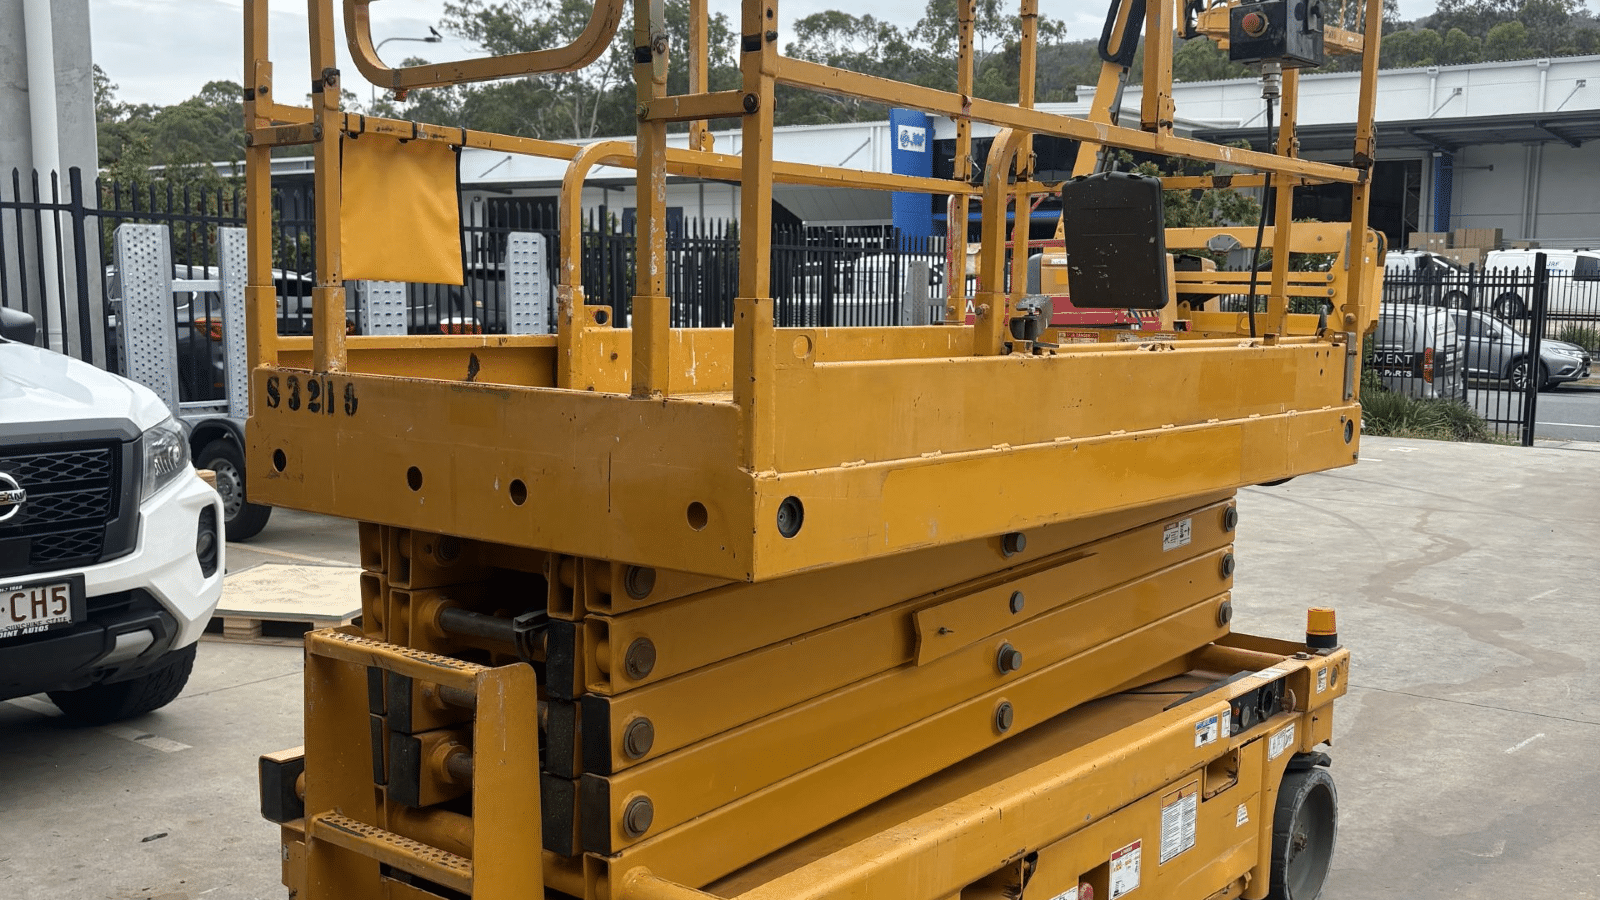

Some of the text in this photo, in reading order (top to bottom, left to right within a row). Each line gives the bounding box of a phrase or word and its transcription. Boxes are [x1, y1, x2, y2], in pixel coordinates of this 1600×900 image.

[6, 616, 68, 630] SUNSHINE STATE
[22, 624, 49, 634] AUTOS
